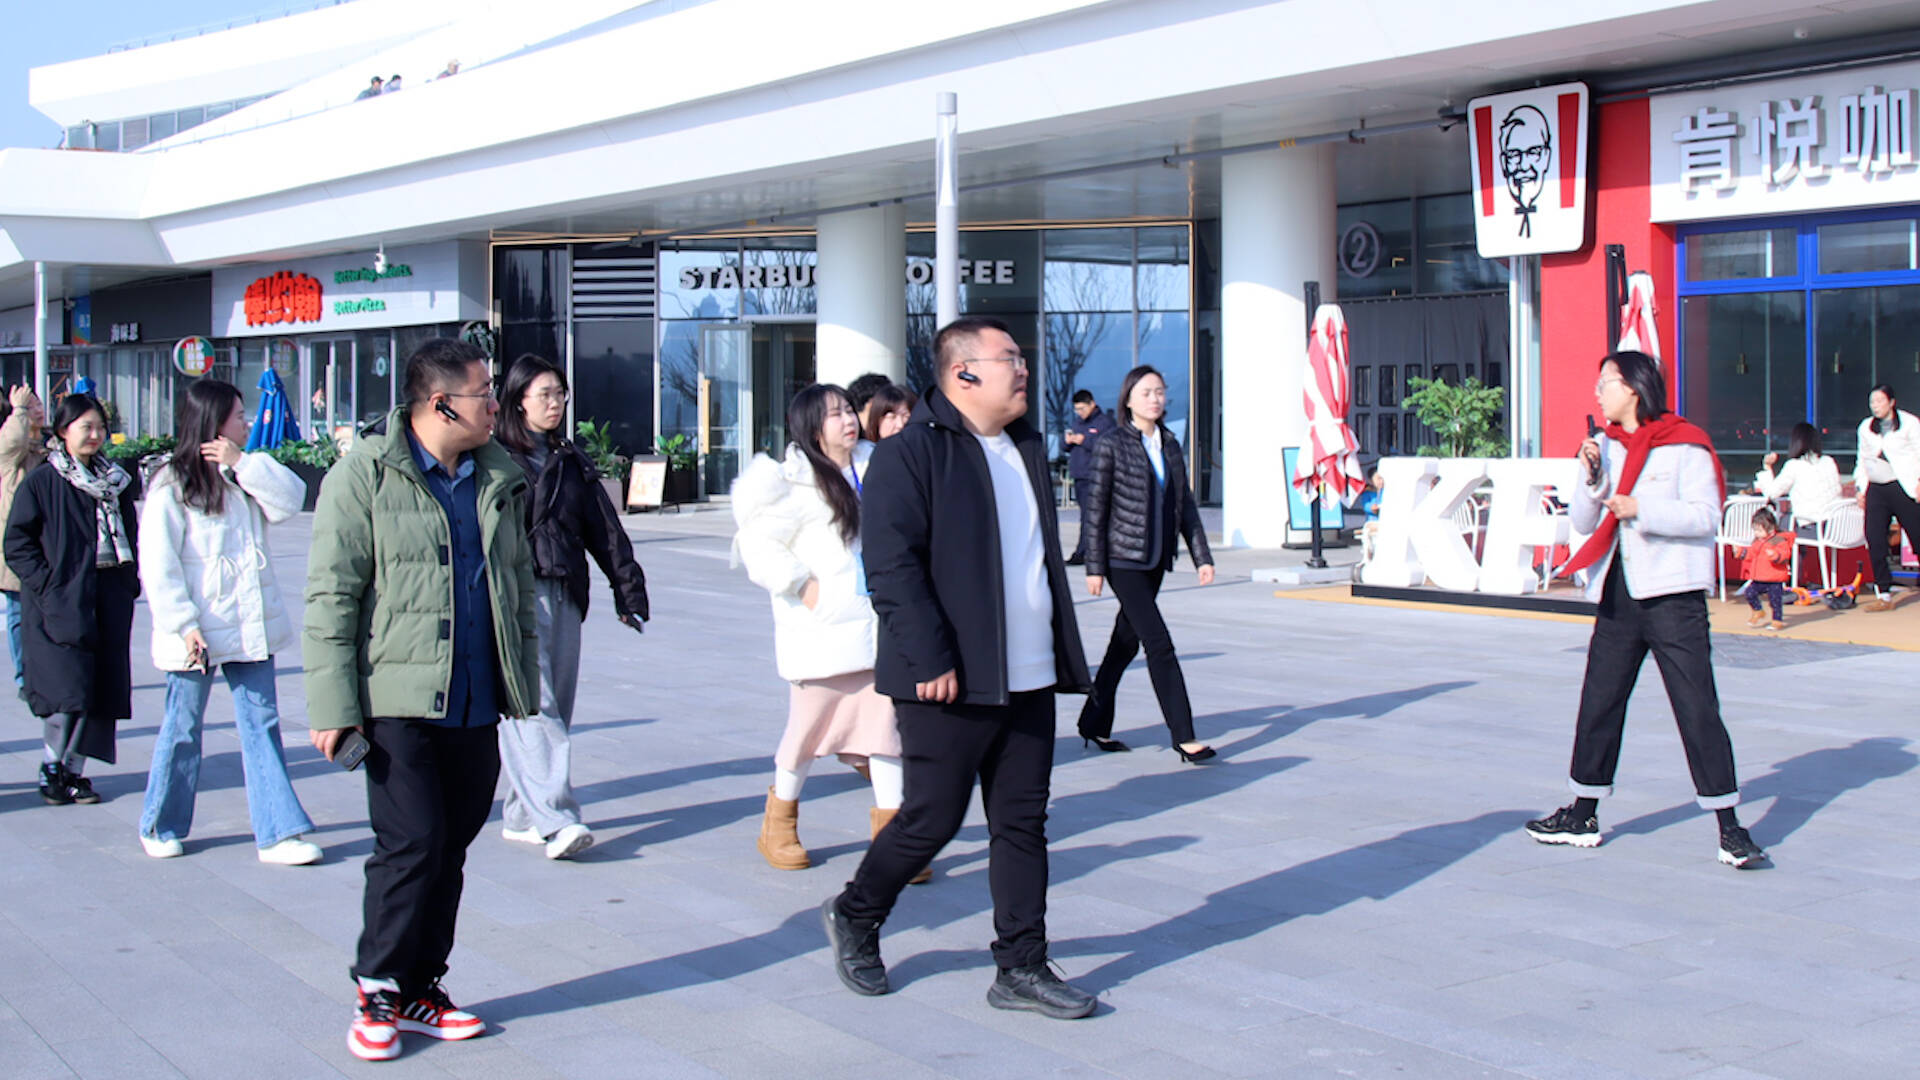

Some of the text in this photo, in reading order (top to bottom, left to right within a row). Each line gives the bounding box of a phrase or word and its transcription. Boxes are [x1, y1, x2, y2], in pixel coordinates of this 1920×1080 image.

[1672, 85, 1917, 193] 肯悦咖
[679, 264, 817, 290] STARBU
[1361, 456, 1600, 596] KF
